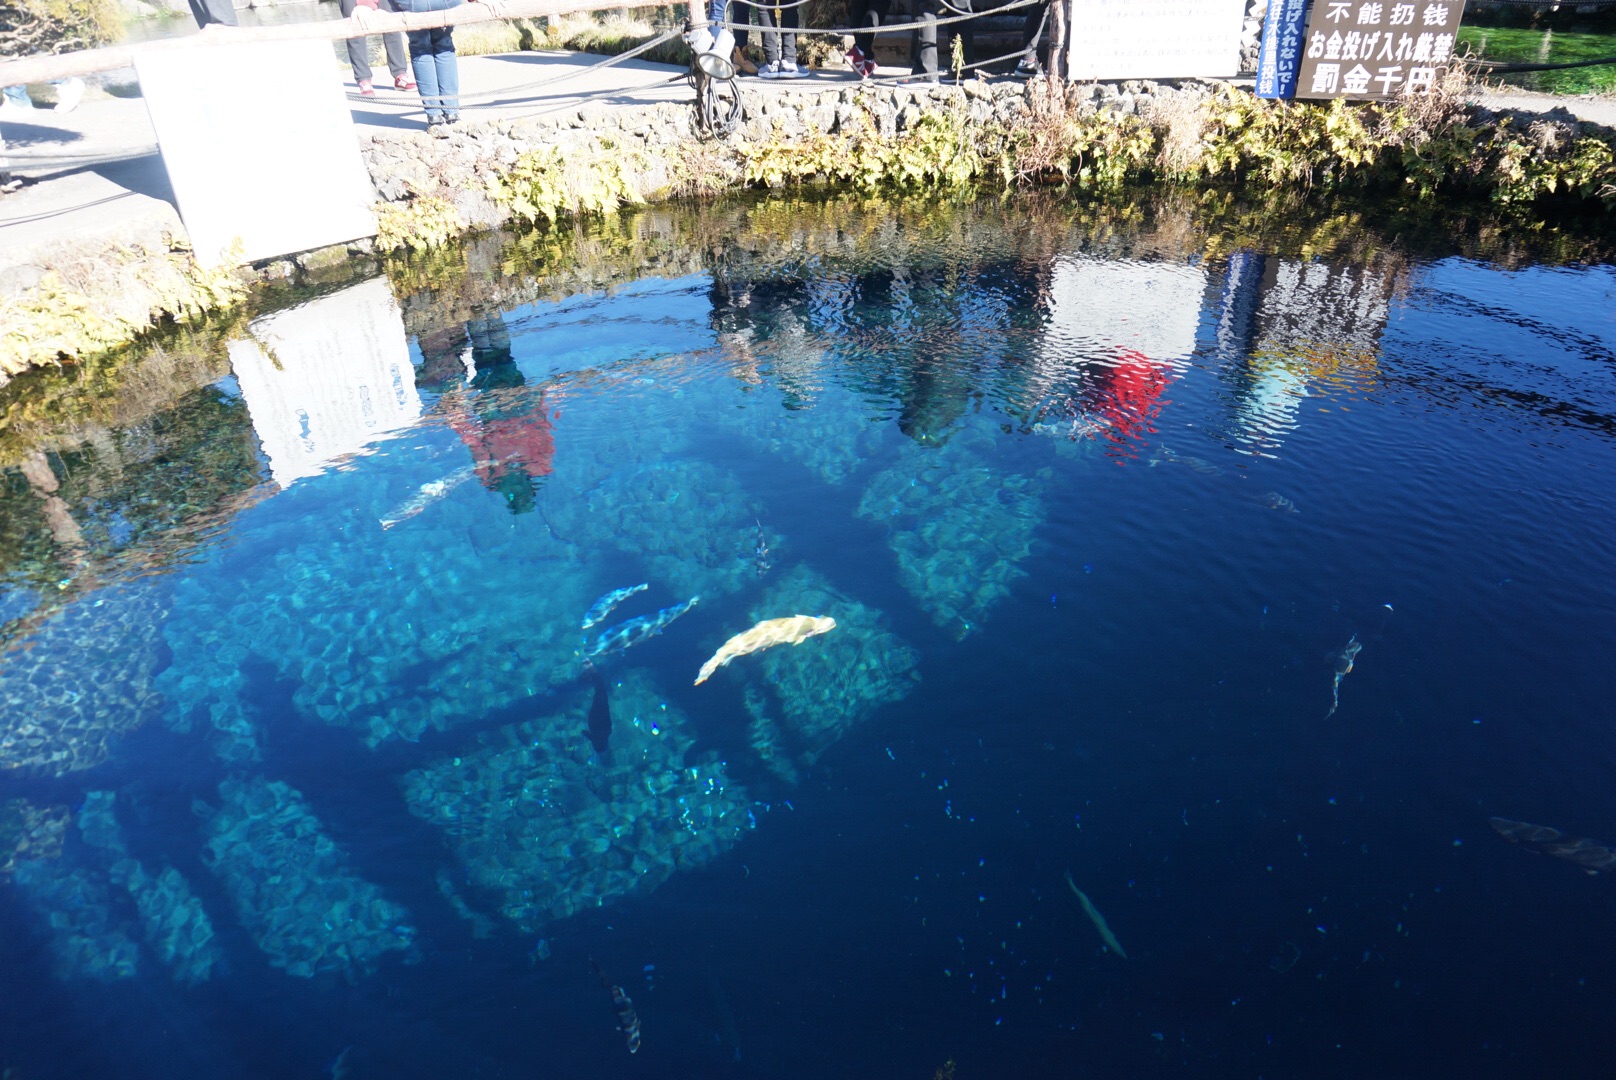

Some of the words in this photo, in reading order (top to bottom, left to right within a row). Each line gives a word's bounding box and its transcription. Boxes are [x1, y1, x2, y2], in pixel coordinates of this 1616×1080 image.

[1326, 2, 1449, 26] 不能扔钱
[1308, 29, 1453, 63] お金投げ入れ厳禁
[1311, 63, 1436, 96] 罰金千円
